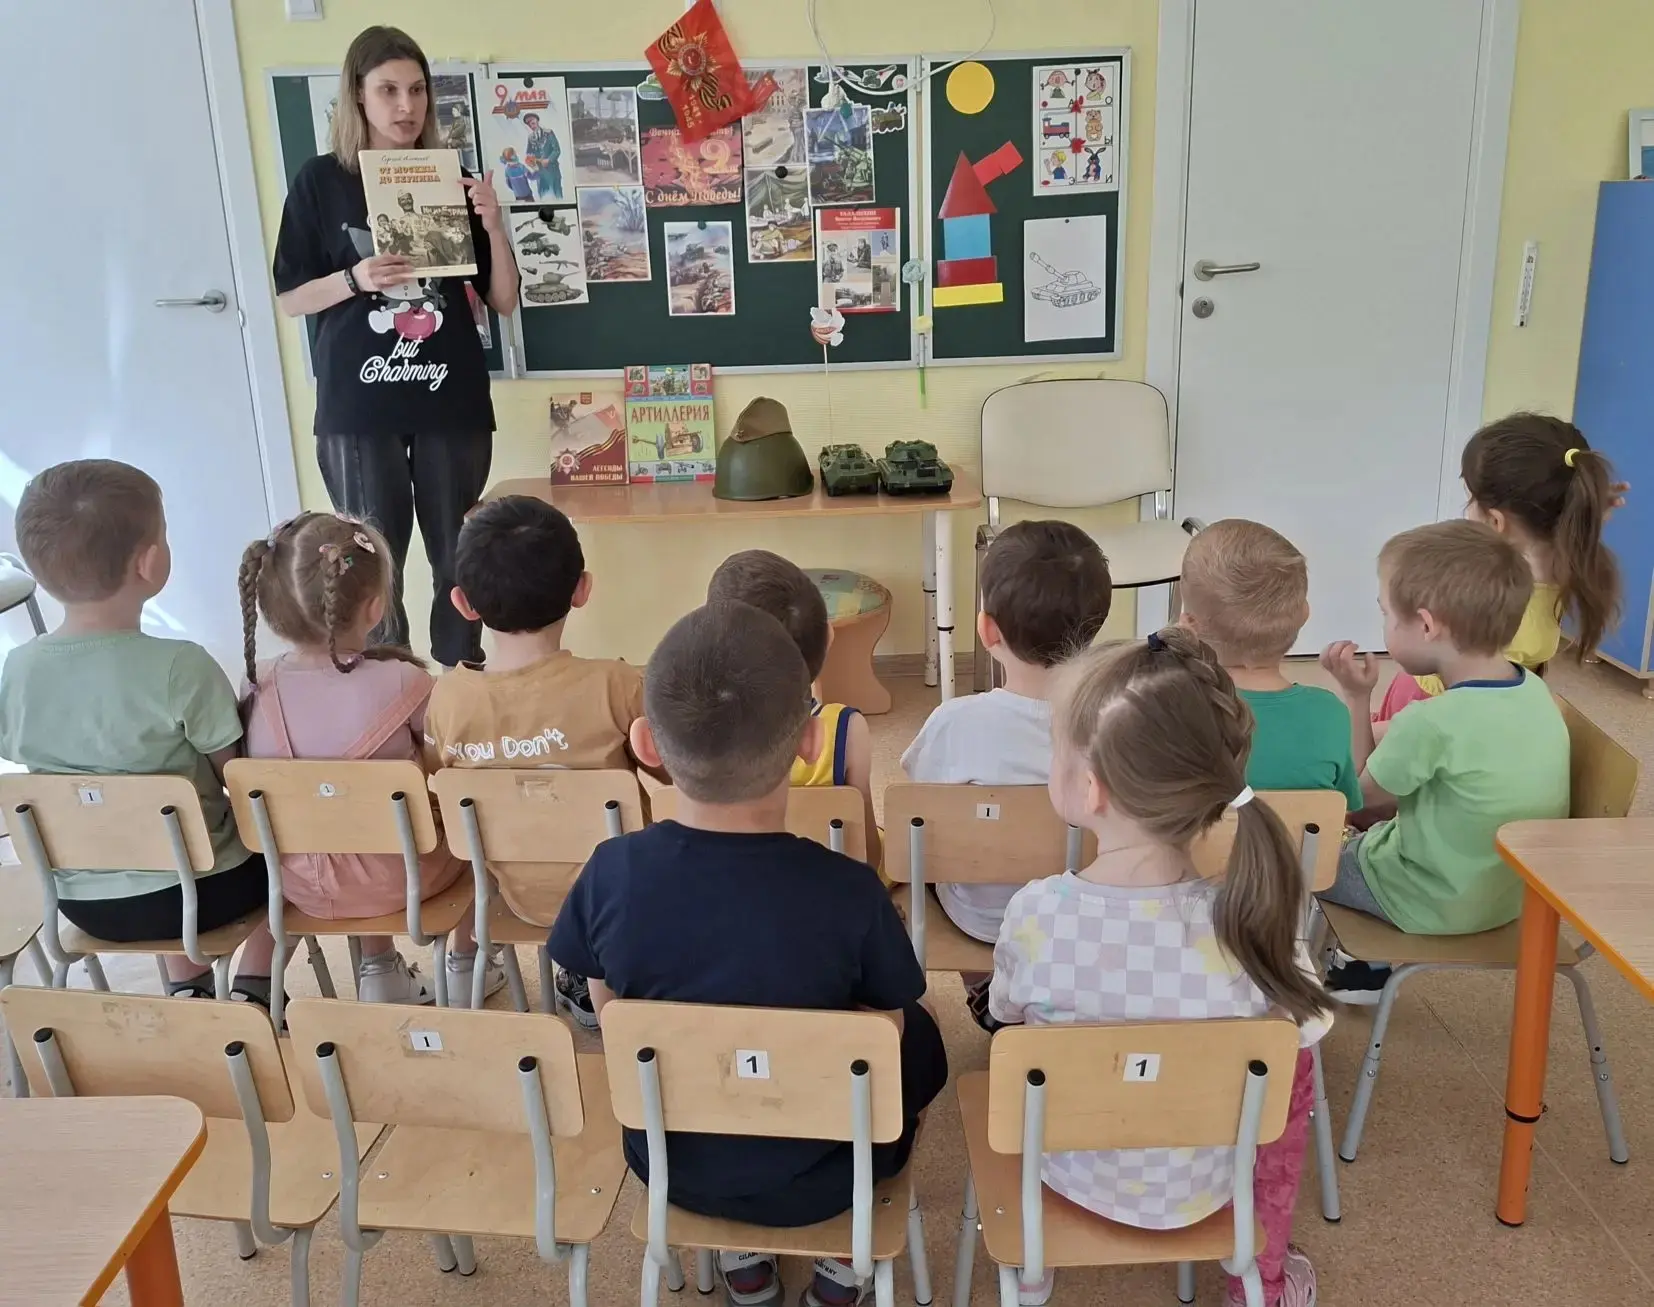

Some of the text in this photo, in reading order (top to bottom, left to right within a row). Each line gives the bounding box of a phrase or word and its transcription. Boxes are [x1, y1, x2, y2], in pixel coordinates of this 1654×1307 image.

[495, 84, 547, 106] 9 МАЯ
[1104, 136, 1113, 145] Ы
[700, 139, 731, 174] 9
[645, 187, 741, 204] С днём Победы!
[391, 332, 424, 359] but
[360, 355, 449, 392] Charming
[631, 404, 709, 424] АРТИЛЛЕРИЯ
[592, 464, 623, 473] ЛЕГЕНДЫ
[595, 473, 623, 481] ПОБЕДЫ
[501, 728, 568, 760] Don't
[746, 1055, 758, 1074] 1
[1135, 1059, 1148, 1077] 1
